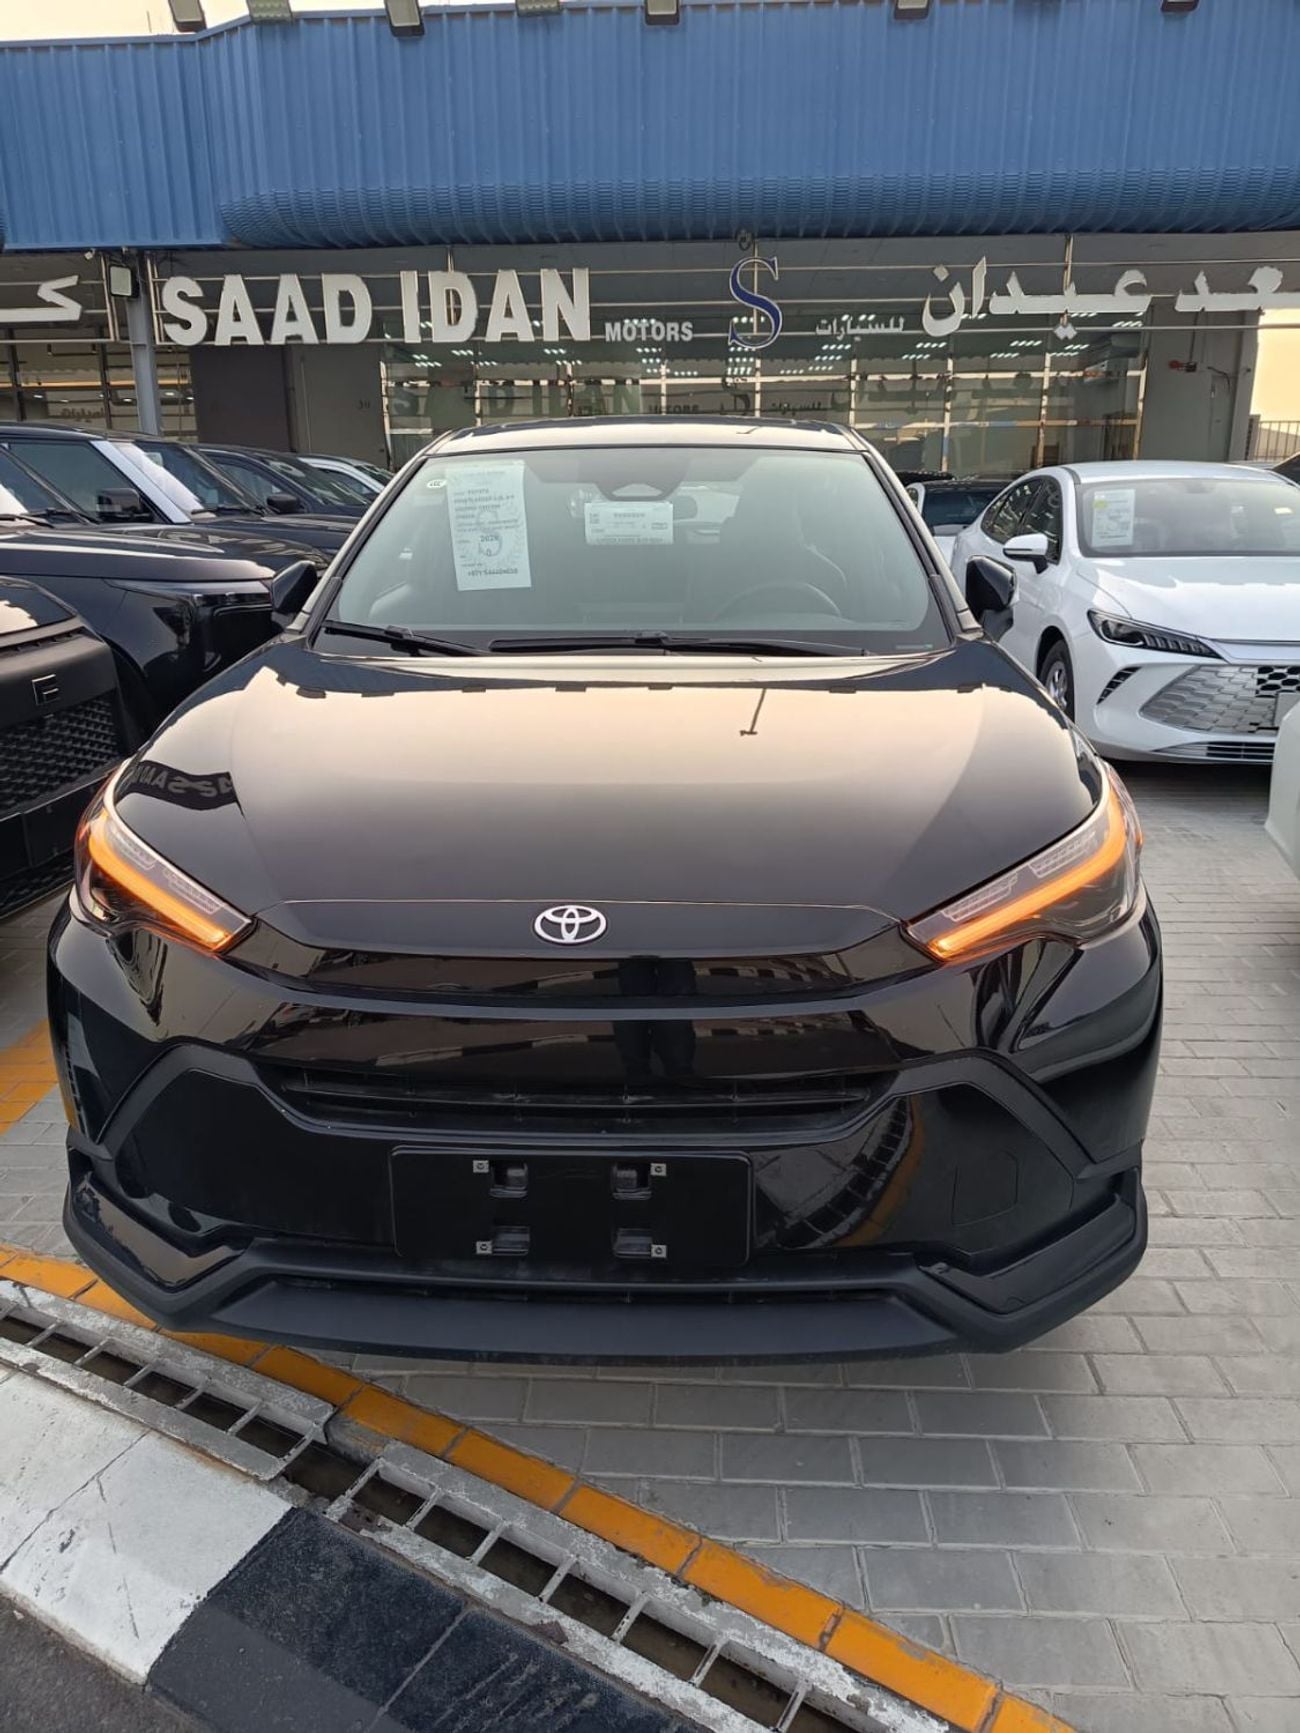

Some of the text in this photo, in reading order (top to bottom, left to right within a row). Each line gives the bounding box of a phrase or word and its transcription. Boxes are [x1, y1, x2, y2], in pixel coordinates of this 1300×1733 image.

[161, 267, 695, 347] SAAD IDAN MOTORS
[728, 256, 783, 349] S
[922, 256, 1151, 338] عيدان
[1174, 265, 1300, 313] عد
